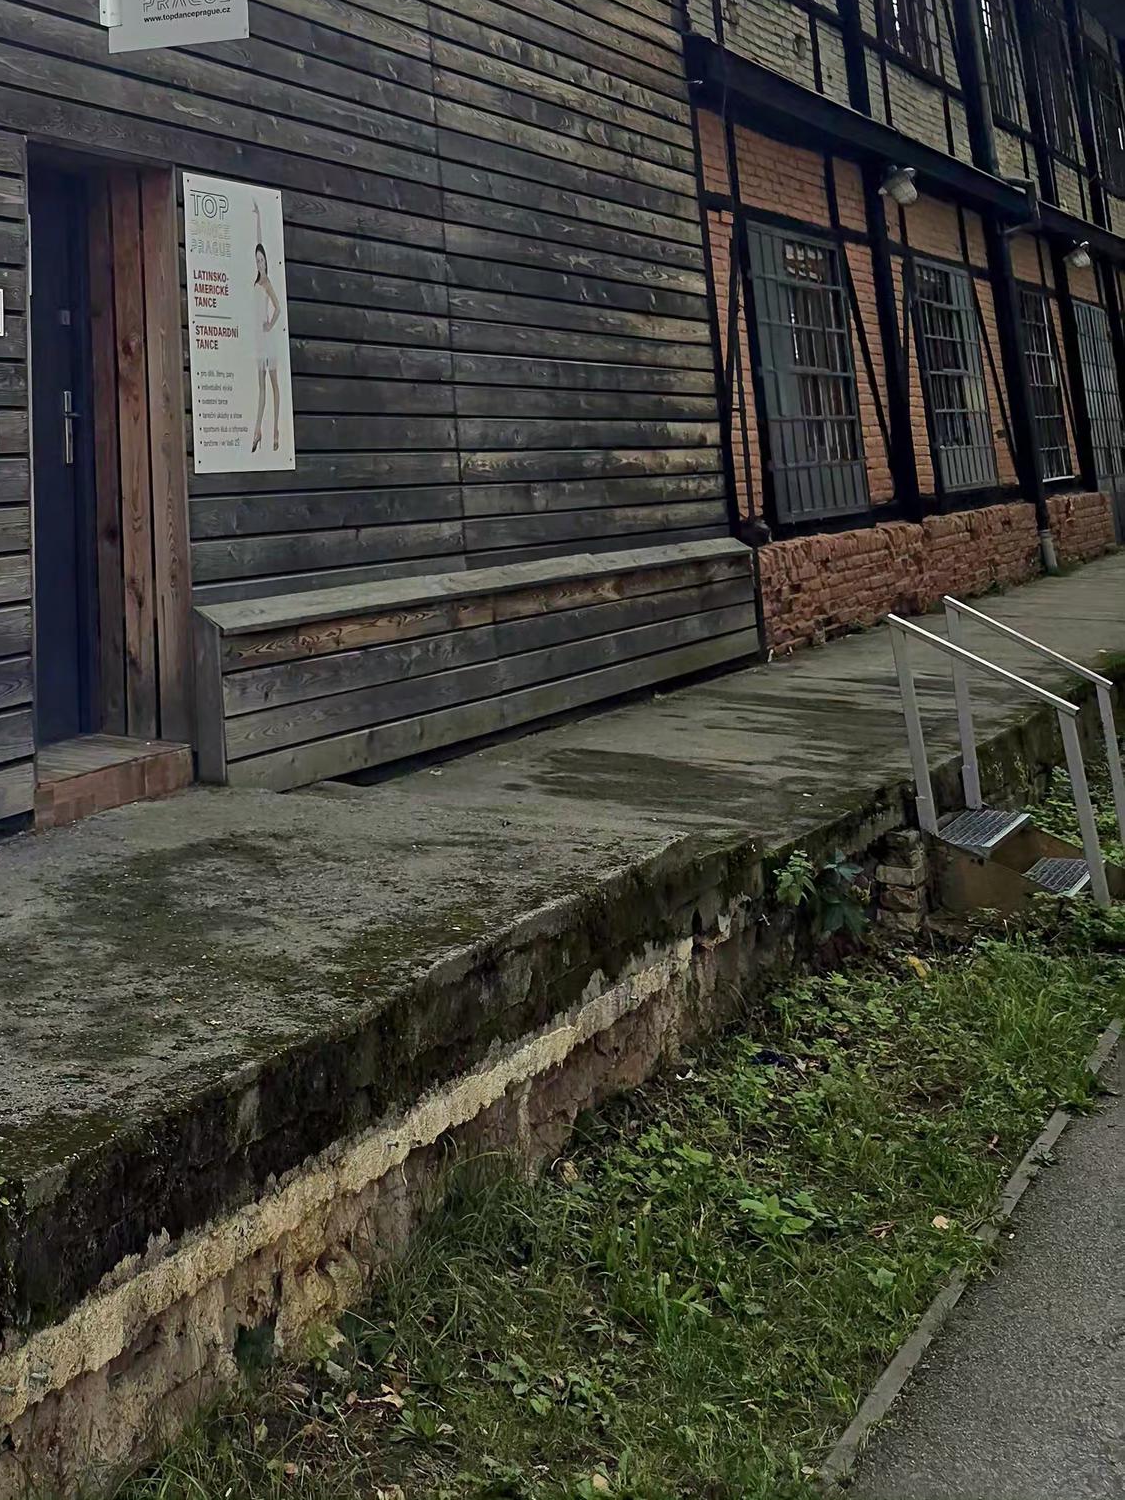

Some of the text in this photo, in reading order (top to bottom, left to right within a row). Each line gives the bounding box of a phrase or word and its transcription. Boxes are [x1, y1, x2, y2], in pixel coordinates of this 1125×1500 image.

[143, 7, 231, 23] www.topdanceprague.cz
[190, 189, 229, 220] TOP
[193, 270, 229, 282] LATINSKO-
[194, 283, 229, 296] AMERICKÉ
[194, 297, 217, 308] TANCE
[195, 325, 239, 338] STANDARDNÍ
[196, 339, 219, 350] TANCE
